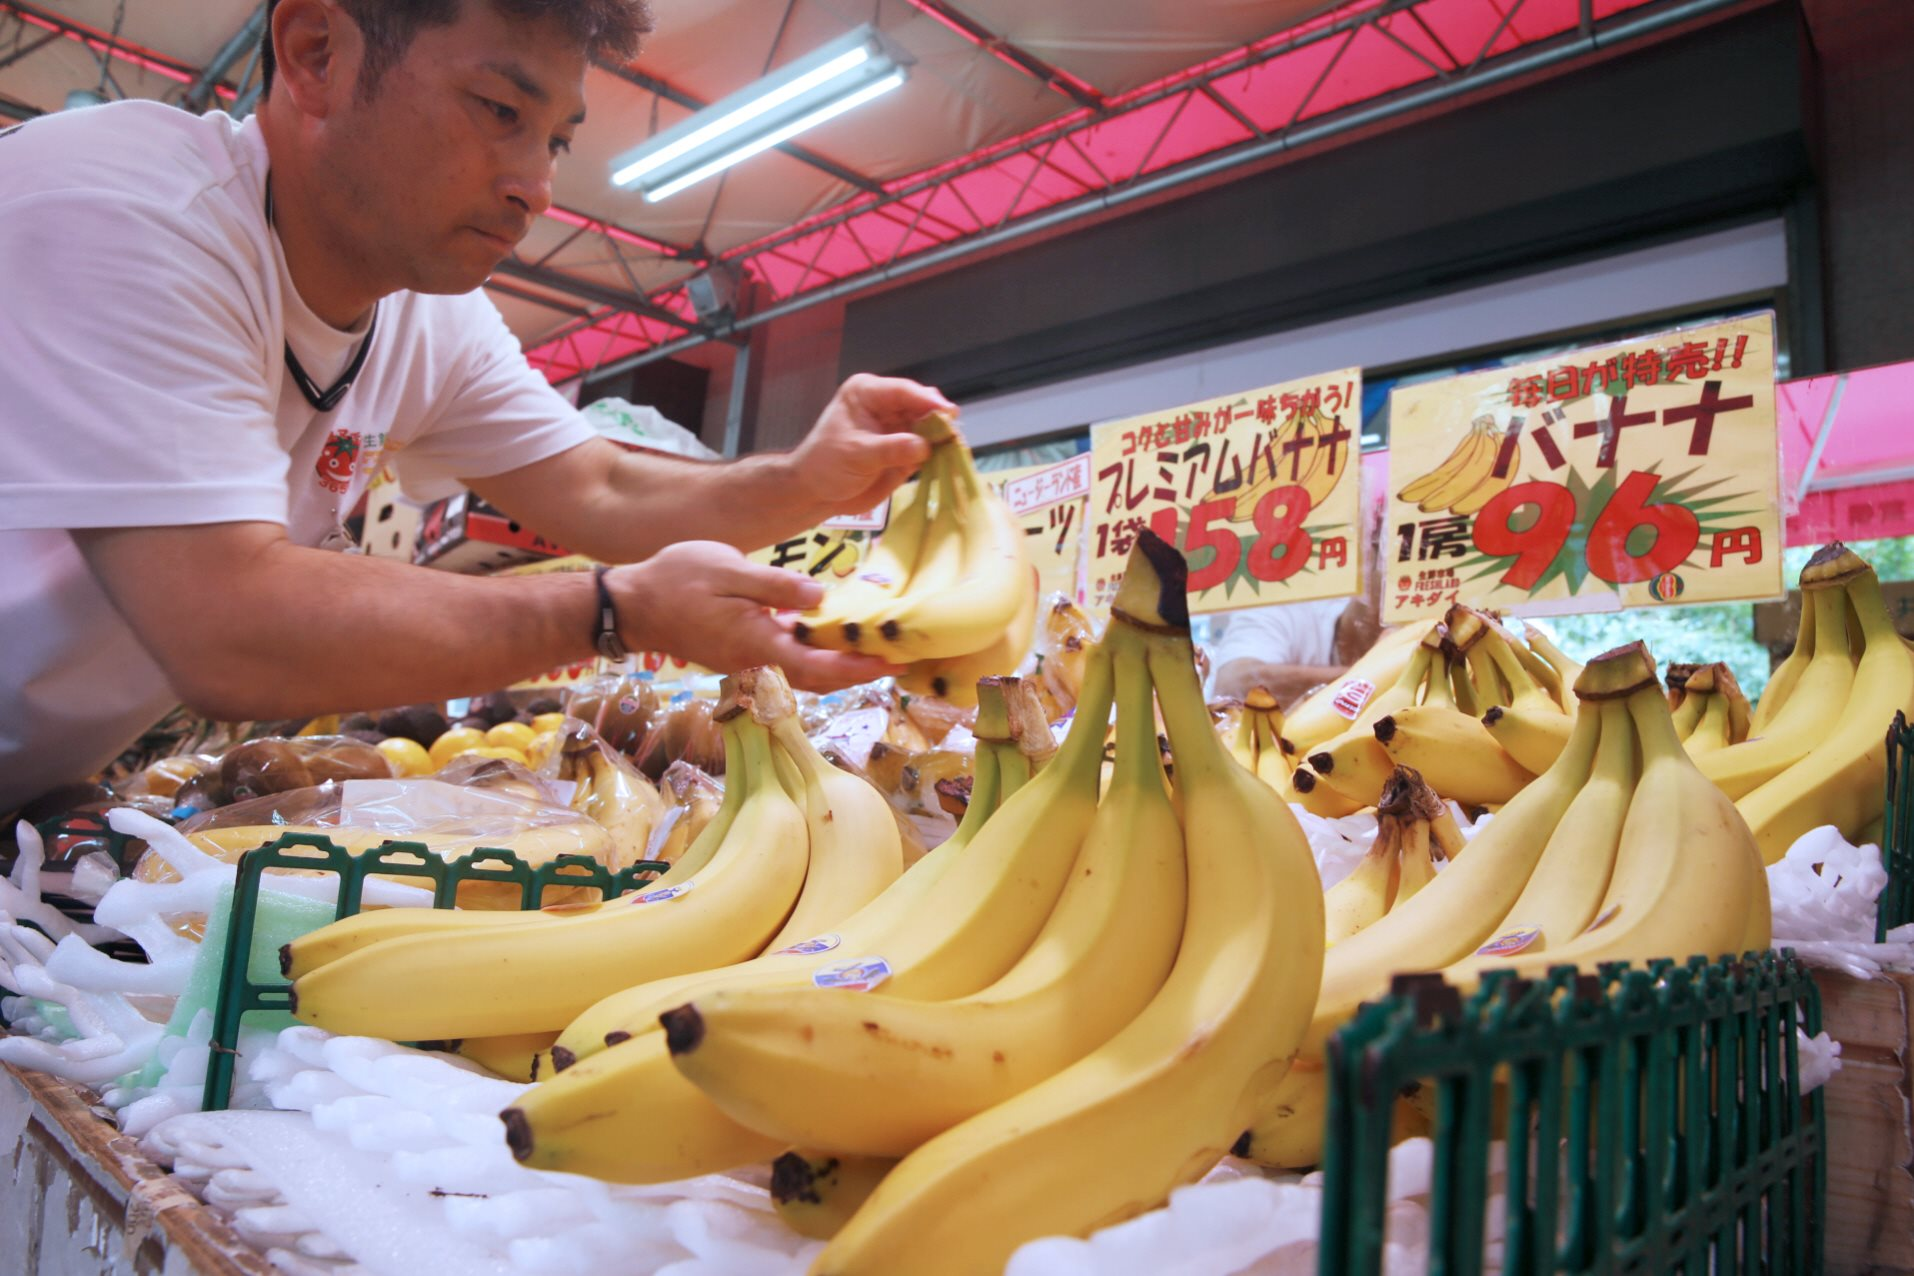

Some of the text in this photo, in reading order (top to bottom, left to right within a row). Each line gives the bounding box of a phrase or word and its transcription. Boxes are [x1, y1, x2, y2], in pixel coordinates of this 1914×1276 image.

[1507, 335, 1748, 408] 毎日が特売!!
[1121, 381, 1353, 456] コクと甘みが一味ちがう!
[1491, 380, 1753, 480] バナナ
[1098, 415, 1352, 515] プレミアムバナナ
[1395, 590, 1460, 609] アキダイ
